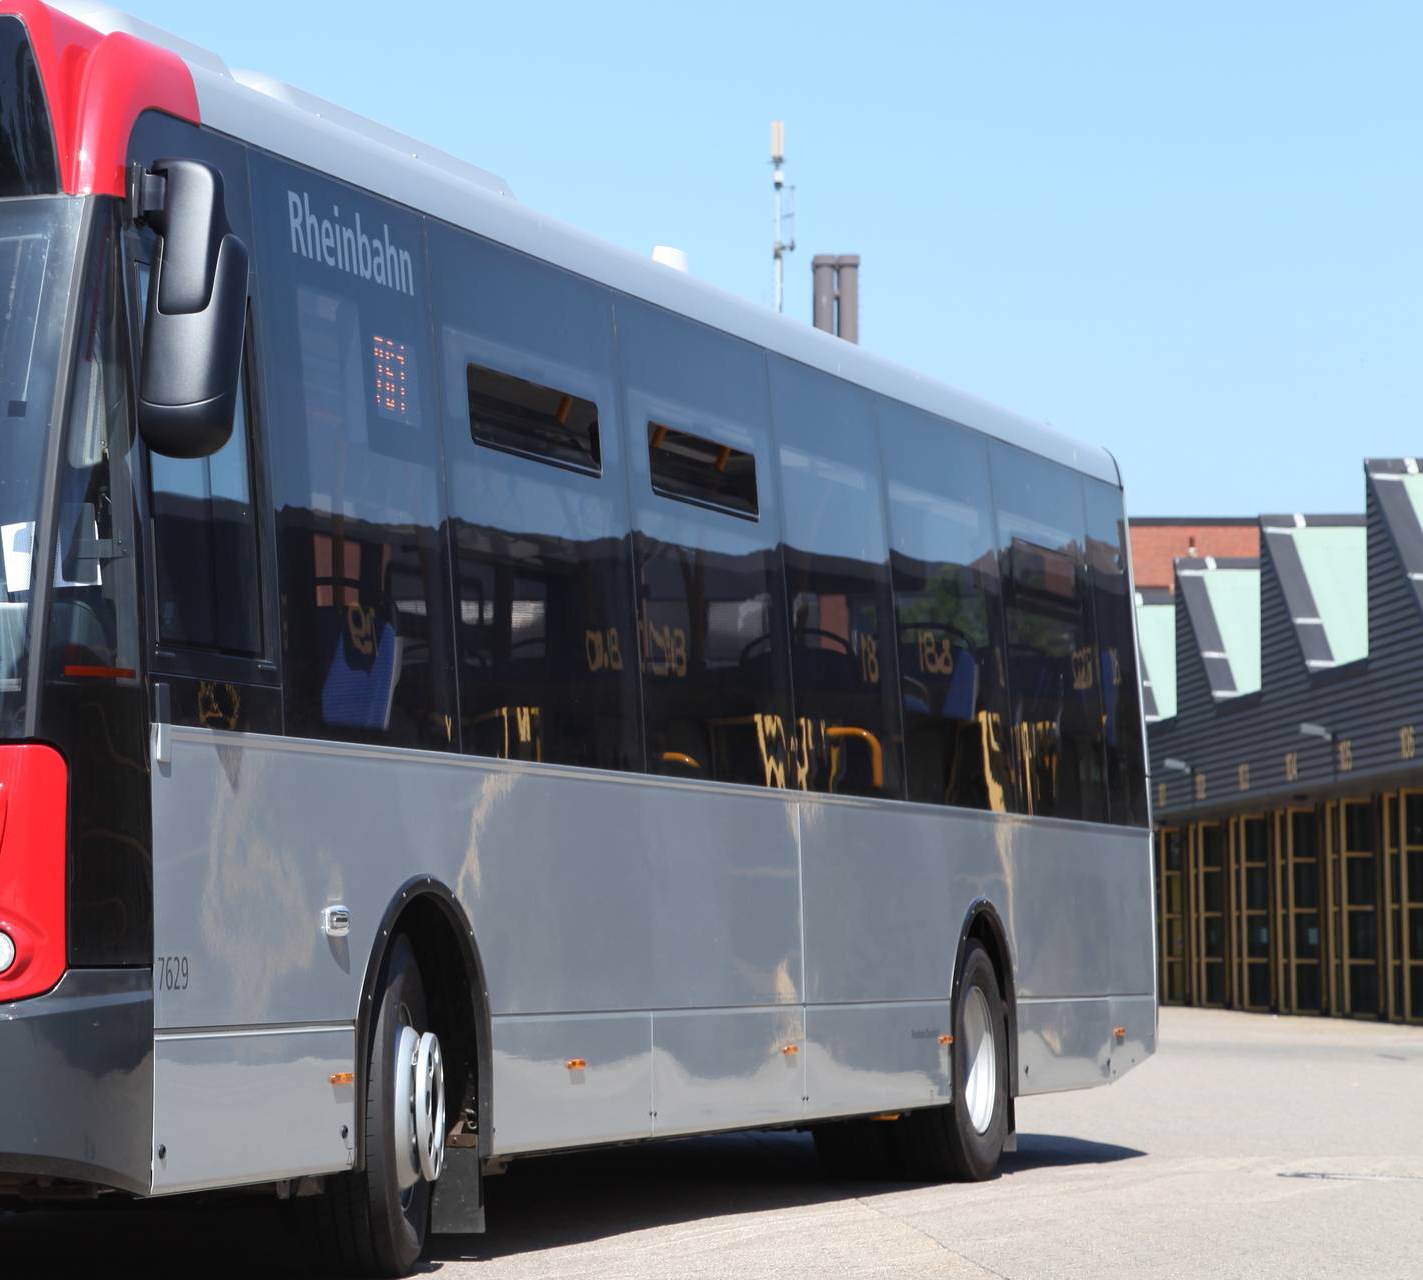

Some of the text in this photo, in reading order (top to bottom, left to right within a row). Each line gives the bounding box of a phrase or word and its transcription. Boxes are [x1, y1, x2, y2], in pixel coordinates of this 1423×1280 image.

[286, 190, 415, 297] Rheinbahn
[373, 336, 405, 413] 761
[157, 956, 189, 991] 7629
